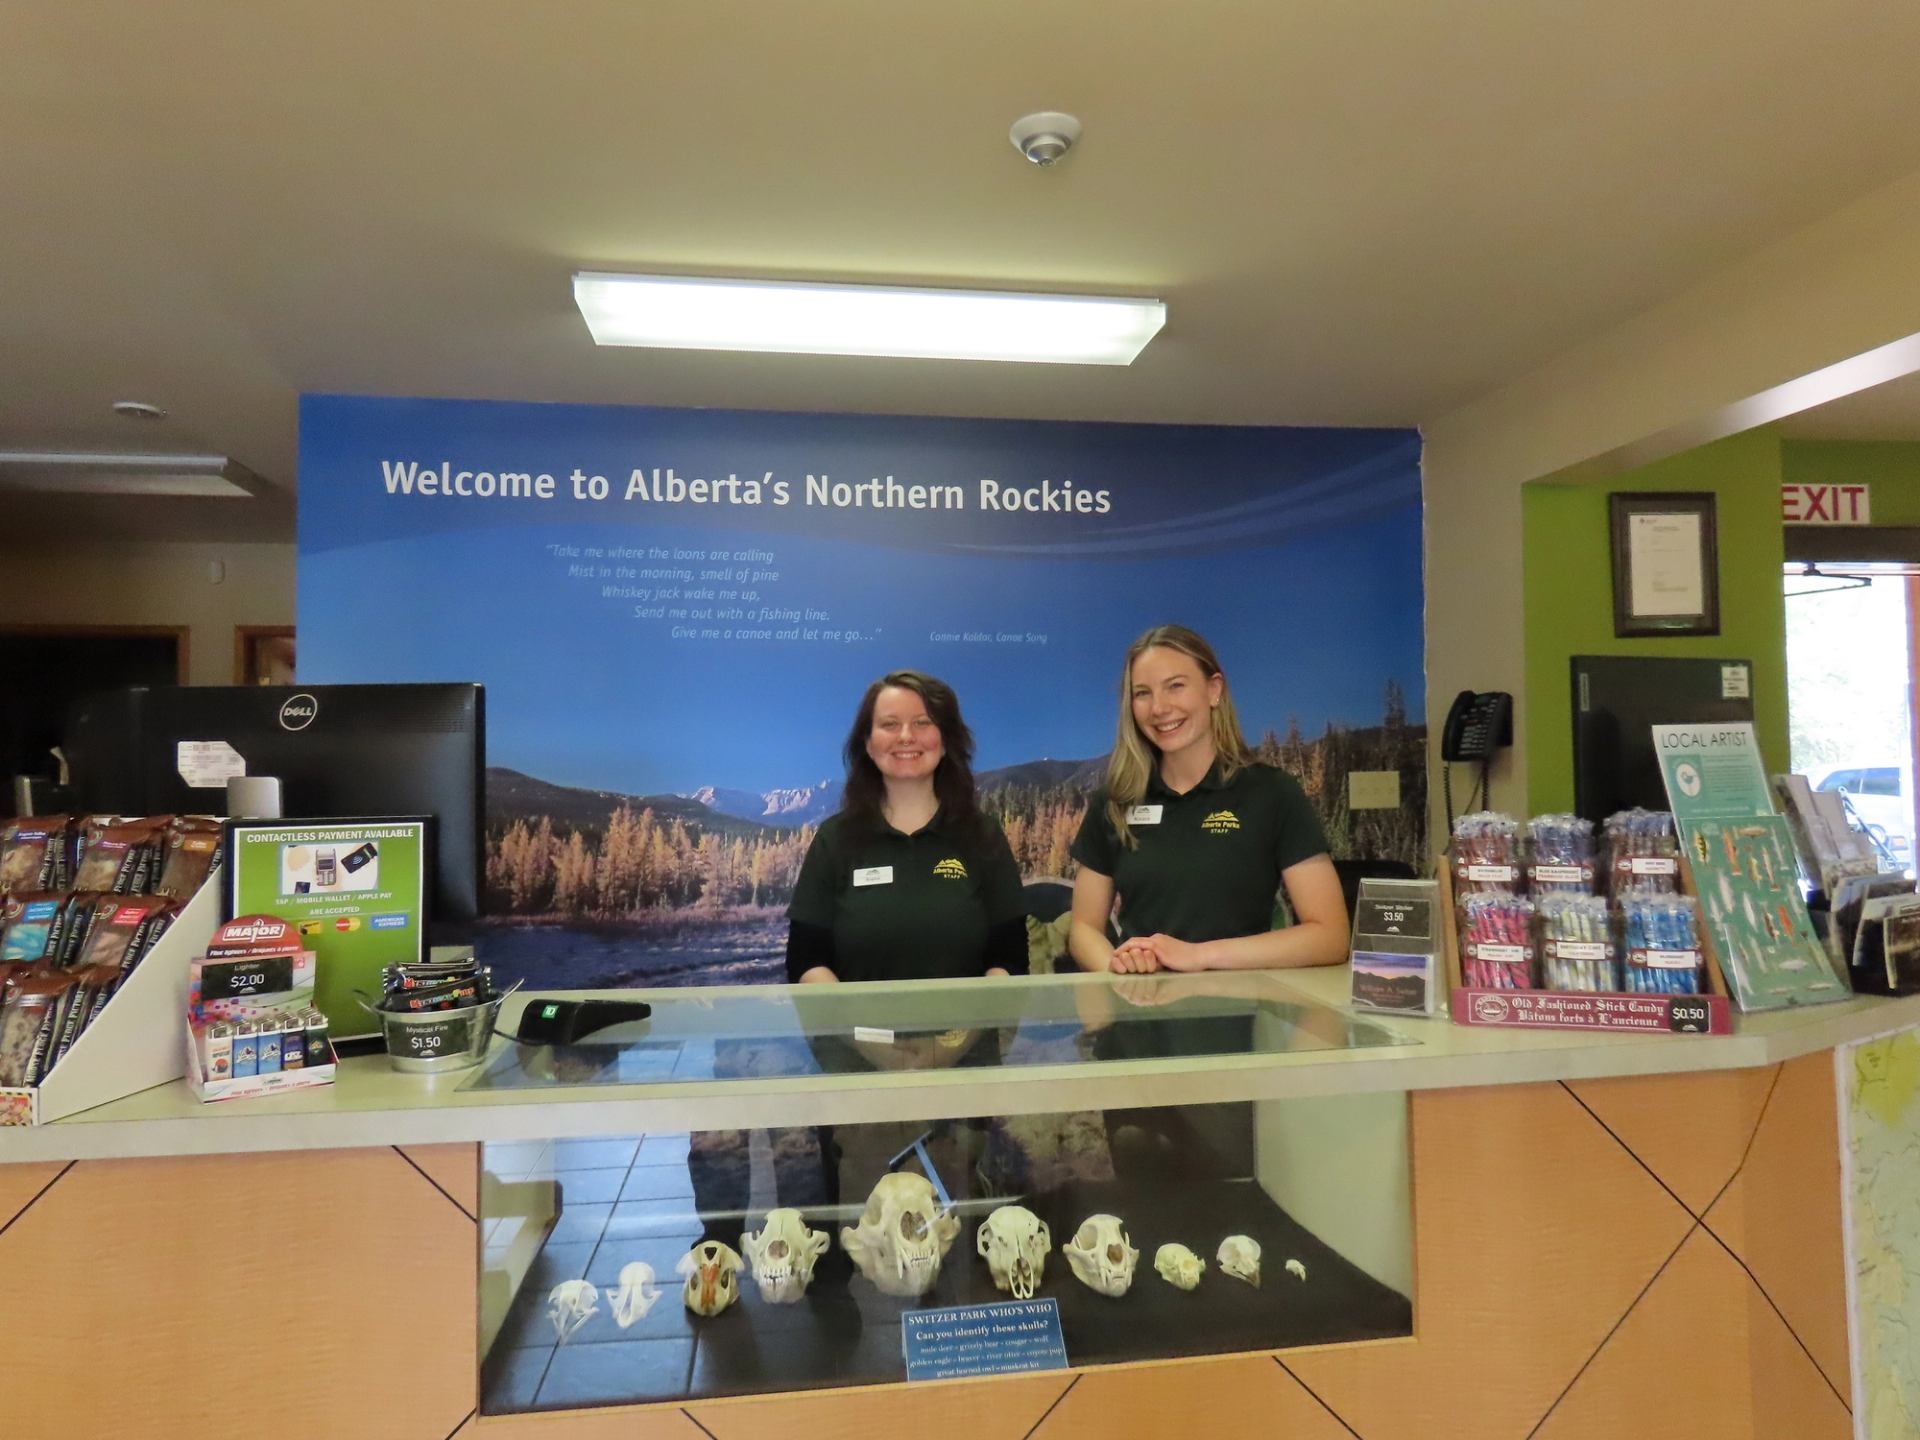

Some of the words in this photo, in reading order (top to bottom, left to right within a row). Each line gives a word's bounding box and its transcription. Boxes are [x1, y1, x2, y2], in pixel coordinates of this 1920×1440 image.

[382, 461, 555, 498] Welcome
[570, 469, 609, 500] to
[624, 469, 789, 505] Alberta's
[806, 475, 964, 509] Northern
[980, 480, 1111, 514] Rockies
[1782, 486, 1865, 522] EXIT
[584, 548, 601, 558] me
[608, 546, 644, 559] where
[649, 547, 669, 560] the
[674, 548, 705, 560] loons
[710, 551, 729, 561] are
[733, 549, 774, 564] calling
[568, 564, 594, 577] Mist
[601, 566, 611, 577] in
[616, 566, 636, 578] the
[640, 566, 695, 582] morning,
[700, 568, 731, 580] smell
[736, 568, 750, 583] of
[752, 569, 779, 582] pine
[602, 585, 650, 600] Whiskey
[653, 586, 680, 601] jack
[684, 587, 714, 600] wake
[719, 590, 737, 600] me
[741, 591, 760, 603] up,
[634, 605, 664, 618] Send
[669, 608, 686, 618] me
[691, 607, 712, 619] out
[717, 607, 743, 620] with
[747, 610, 755, 620] a
[758, 607, 800, 623] fishing
[805, 608, 830, 621] line.
[671, 625, 696, 639] Give
[701, 629, 719, 639] me
[724, 630, 732, 640] a
[735, 629, 772, 640] canoe
[776, 627, 799, 640] and
[803, 628, 818, 641] let
[823, 630, 840, 640] me
[996, 632, 1023, 642] Canoe
[1025, 632, 1047, 645] Song
[284, 706, 312, 717] DELL
[1662, 732, 1707, 748] LOCAL
[1710, 731, 1746, 747] ARTIST
[247, 832, 316, 844] CONTACTLESS
[318, 831, 363, 842] PAYMENT
[364, 828, 414, 840] AVAILABLE
[296, 896, 322, 904] MOBILE
[325, 894, 350, 903] WALLET
[325, 906, 360, 915] ACCEPTED
[226, 923, 281, 943] MAJOR
[234, 963, 260, 972] Lighter
[230, 973, 265, 988] $2.00
[1512, 997, 1532, 1009] Old
[1535, 998, 1591, 1014] Fashioned
[1596, 998, 1626, 1013] Stick
[1628, 999, 1664, 1017] Candy
[1671, 1007, 1705, 1021] $0.50
[1517, 1008, 1556, 1023] Bâtons
[1559, 1011, 1584, 1024] forts
[1587, 1012, 1595, 1024] à
[1598, 1012, 1659, 1027] L'ancienne
[406, 1025, 433, 1035] Mystical
[411, 1036, 441, 1049] $1.50
[908, 1313, 957, 1325] SWITZER
[960, 1310, 986, 1321] PARK
[989, 1306, 1024, 1318] WHO'S
[1025, 1303, 1052, 1314] WHO
[916, 1330, 933, 1341] Can
[936, 1330, 953, 1342] you
[954, 1325, 990, 1339] identify
[992, 1323, 1016, 1334] these
[1018, 1319, 1049, 1331] skulls?
[939, 1344, 954, 1352] deer
[959, 1341, 983, 1352] grizzly
[984, 1340, 1000, 1349] bear
[1005, 1338, 1028, 1348] cougar
[1033, 1334, 1049, 1343] wolf
[982, 1365, 995, 1373] owl
